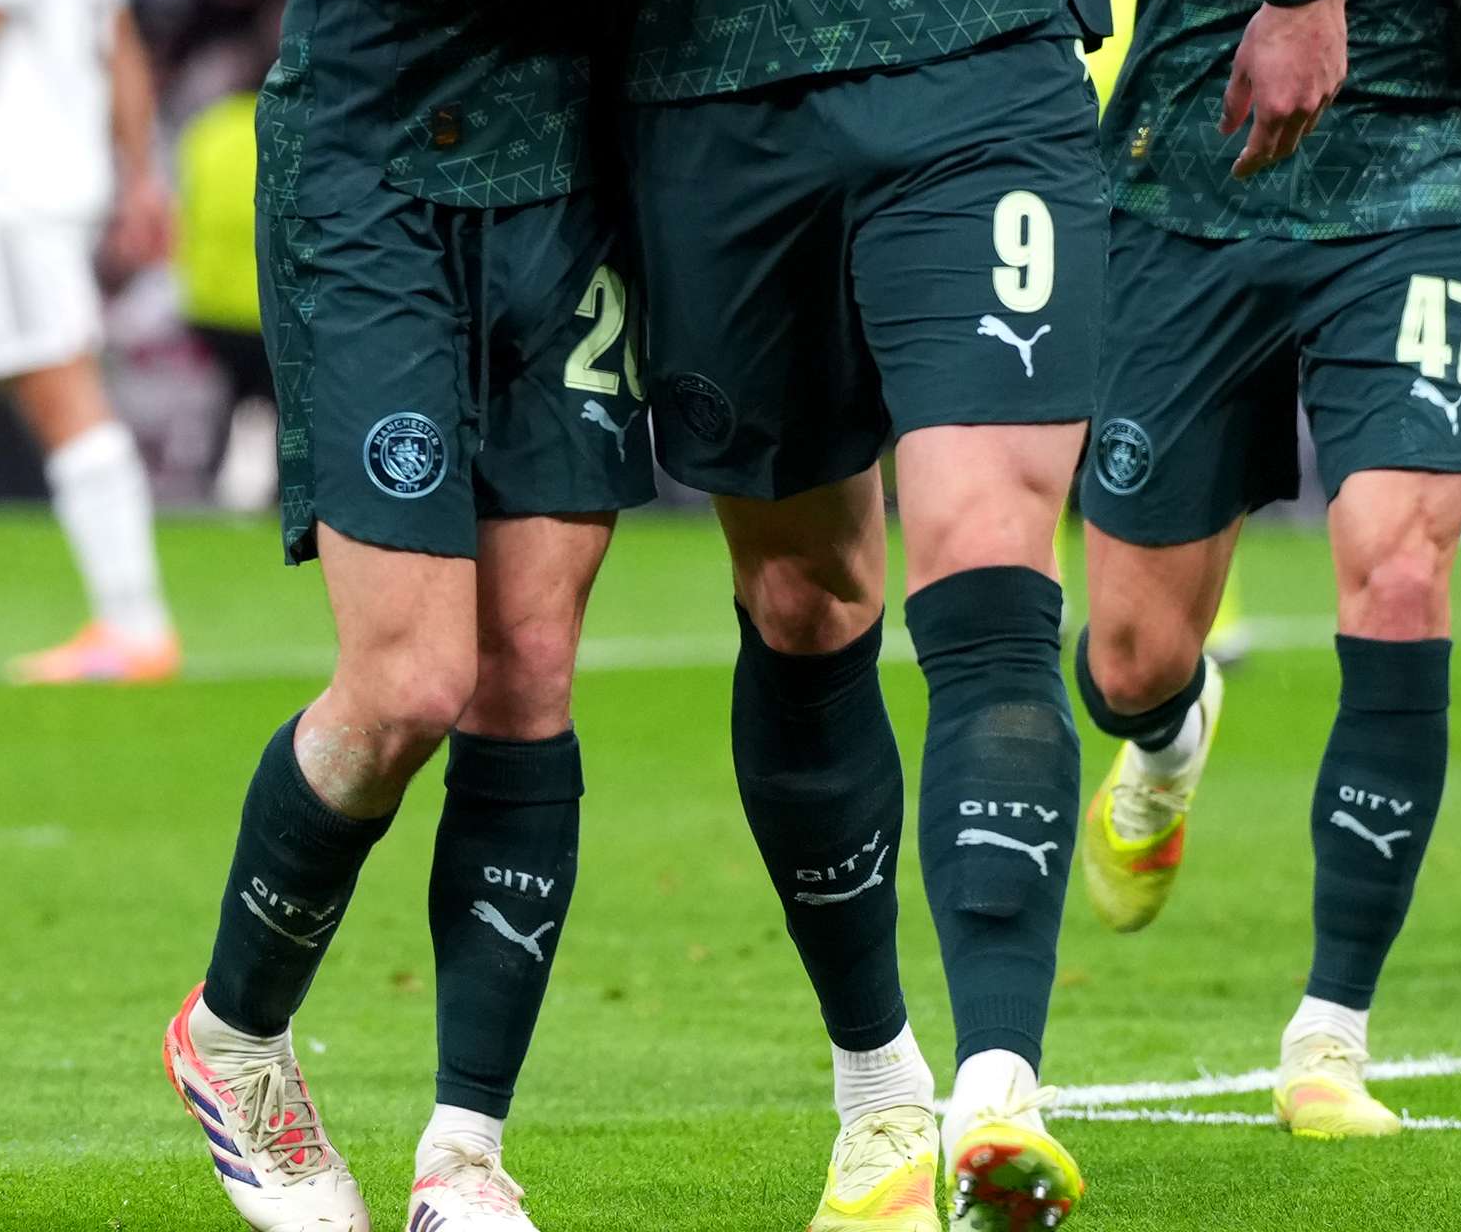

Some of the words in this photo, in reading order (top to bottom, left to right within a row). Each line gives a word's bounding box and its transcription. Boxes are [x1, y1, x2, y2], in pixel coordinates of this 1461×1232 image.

[992, 190, 1055, 314] 9
[373, 418, 440, 447] MANCHESTER
[395, 482, 421, 493] CITY
[959, 800, 1059, 823] CITY
[1339, 785, 1413, 816] CITY
[796, 829, 881, 882] CITY
[483, 865, 555, 898] CITY
[251, 875, 336, 921] CITY
